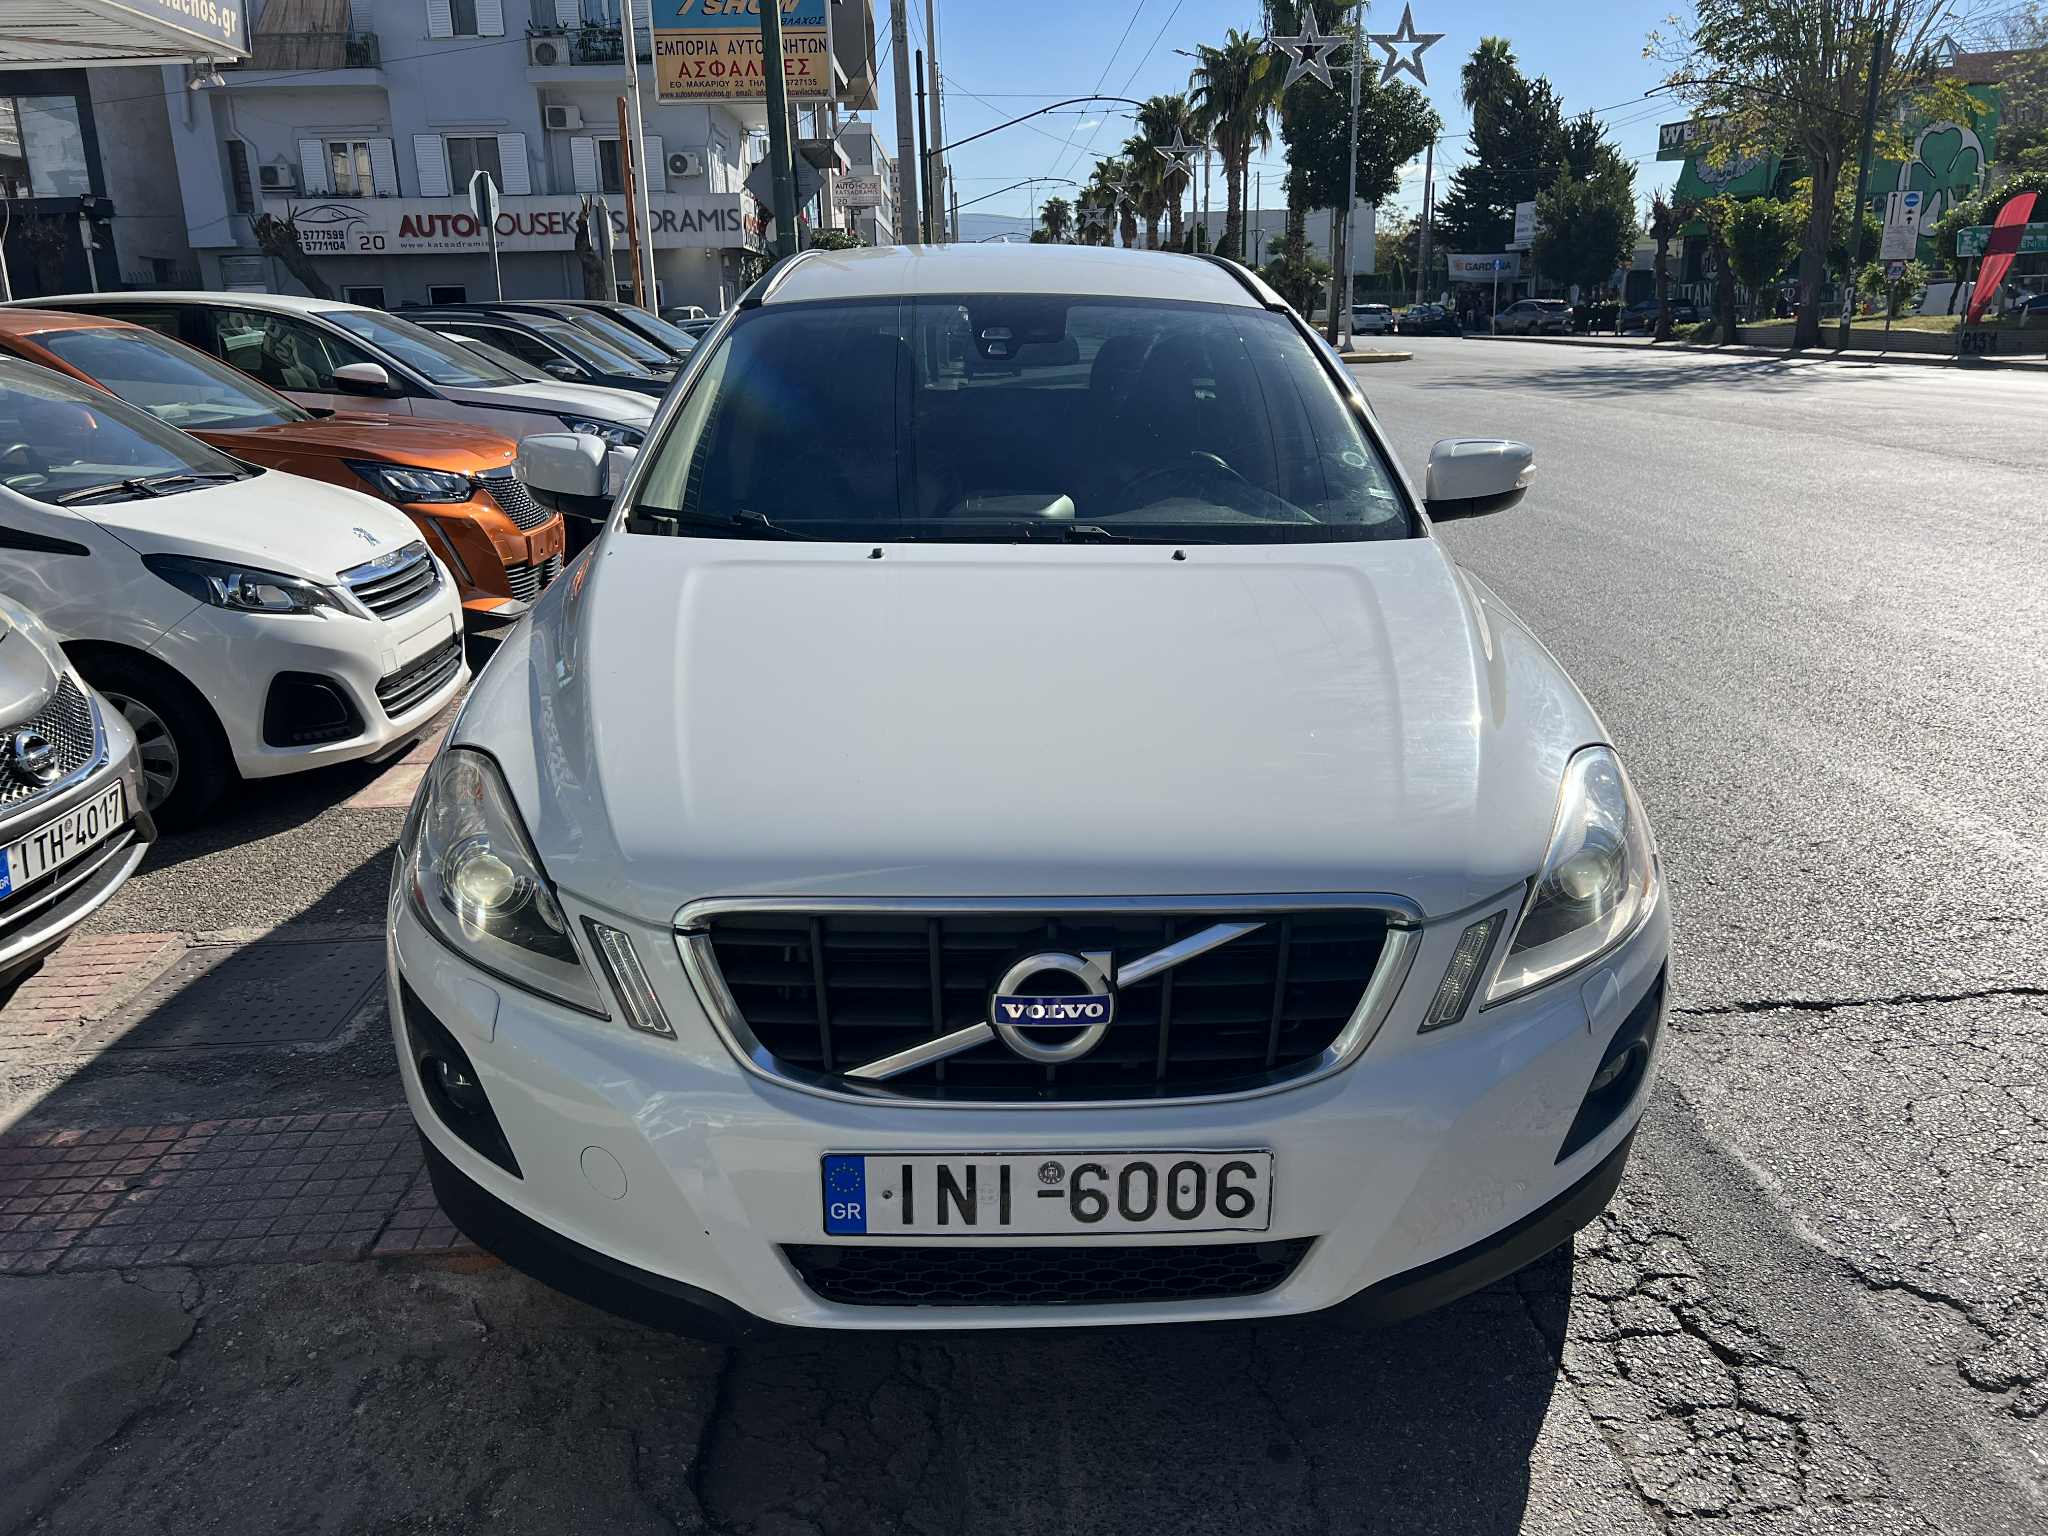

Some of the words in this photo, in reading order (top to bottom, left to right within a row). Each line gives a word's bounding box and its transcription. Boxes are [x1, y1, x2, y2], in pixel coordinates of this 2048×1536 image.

[656, 39, 719, 56] ΕΜΠΟΡΙΑ
[727, 38, 828, 56] ΑΥΤΟΝΗΤΩΝ
[678, 58, 811, 79] ΑΣΦΑΛΕΣ
[686, 80, 731, 88] ΜΑΚΑΡΙΟΥ
[359, 235, 385, 250] 20
[1002, 1003, 1104, 1018] VOLVO
[831, 1202, 862, 1219] GR
